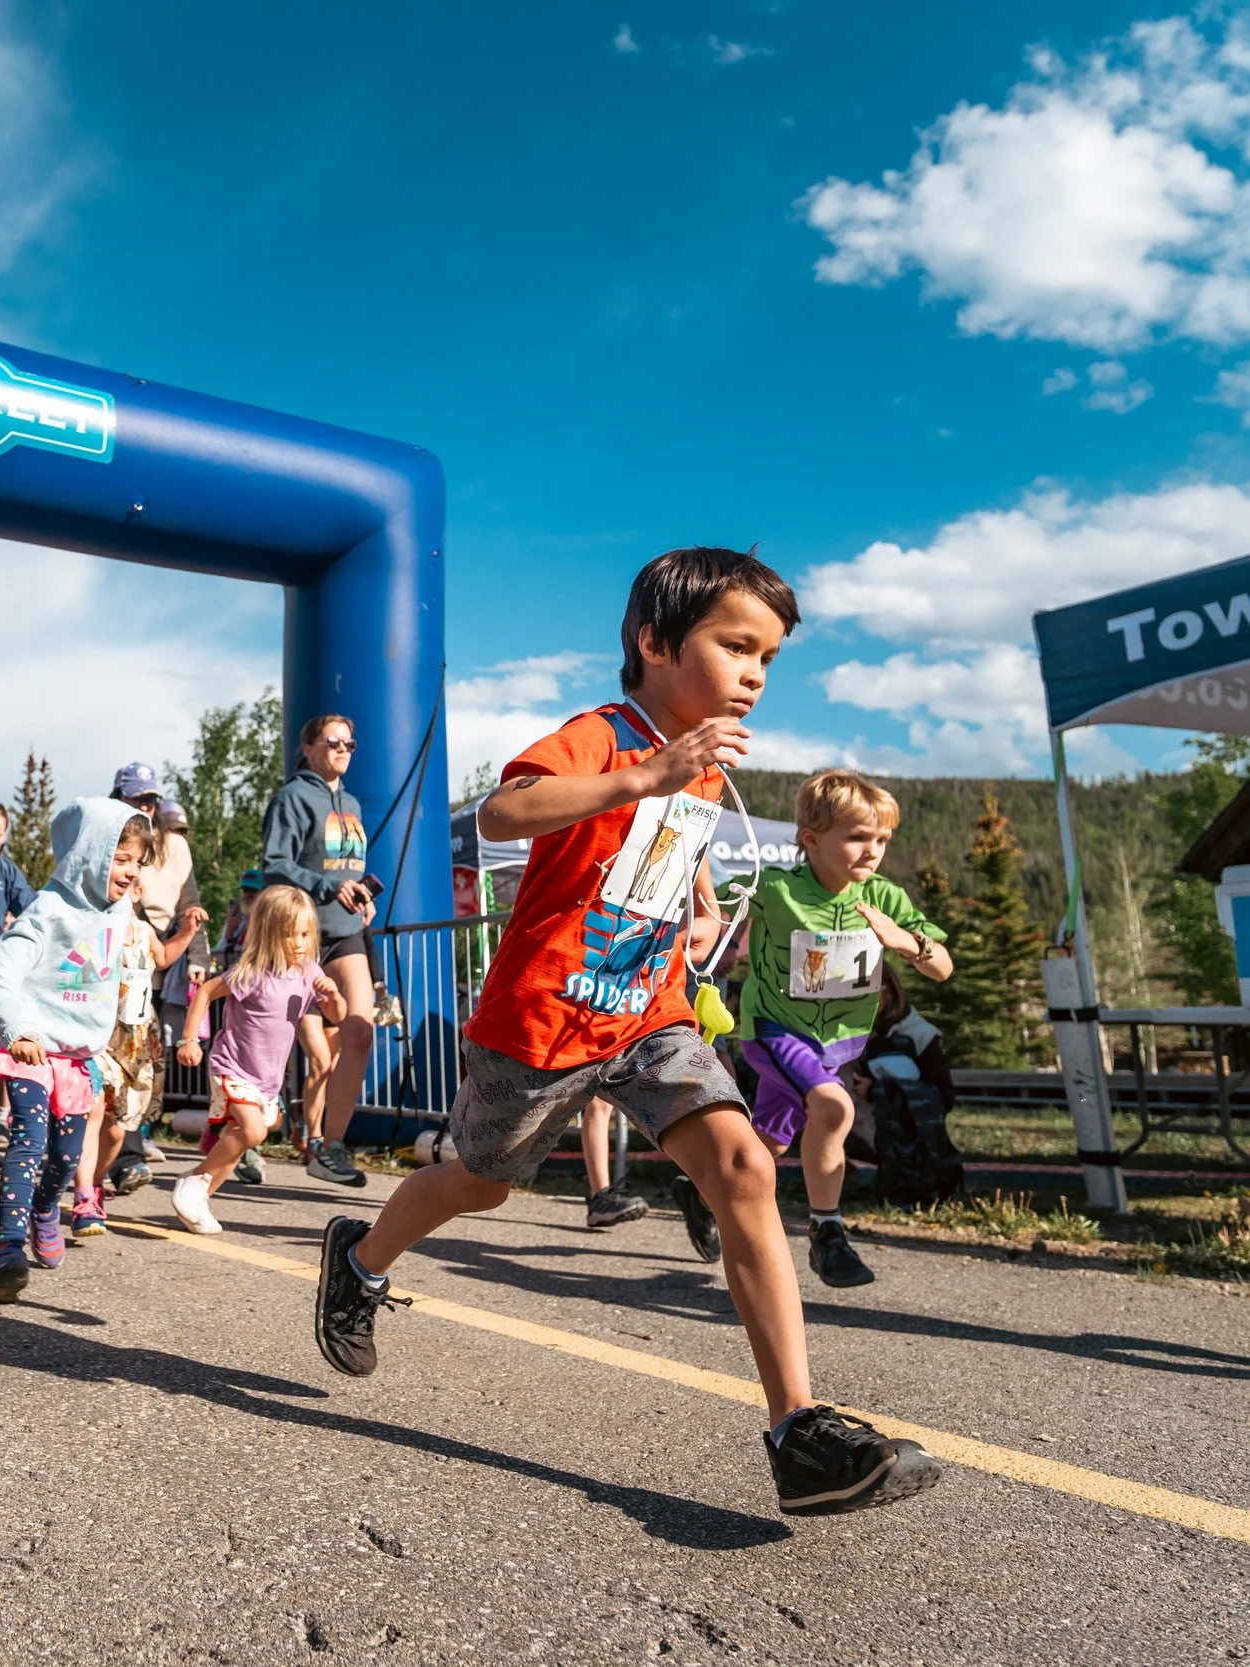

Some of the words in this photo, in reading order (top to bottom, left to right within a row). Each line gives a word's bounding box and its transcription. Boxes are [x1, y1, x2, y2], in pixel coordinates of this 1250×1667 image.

[852, 950, 871, 989] 1
[63, 991, 89, 1002] RISE
[138, 986, 148, 1018] 1
[560, 973, 650, 1015] SPIDER
